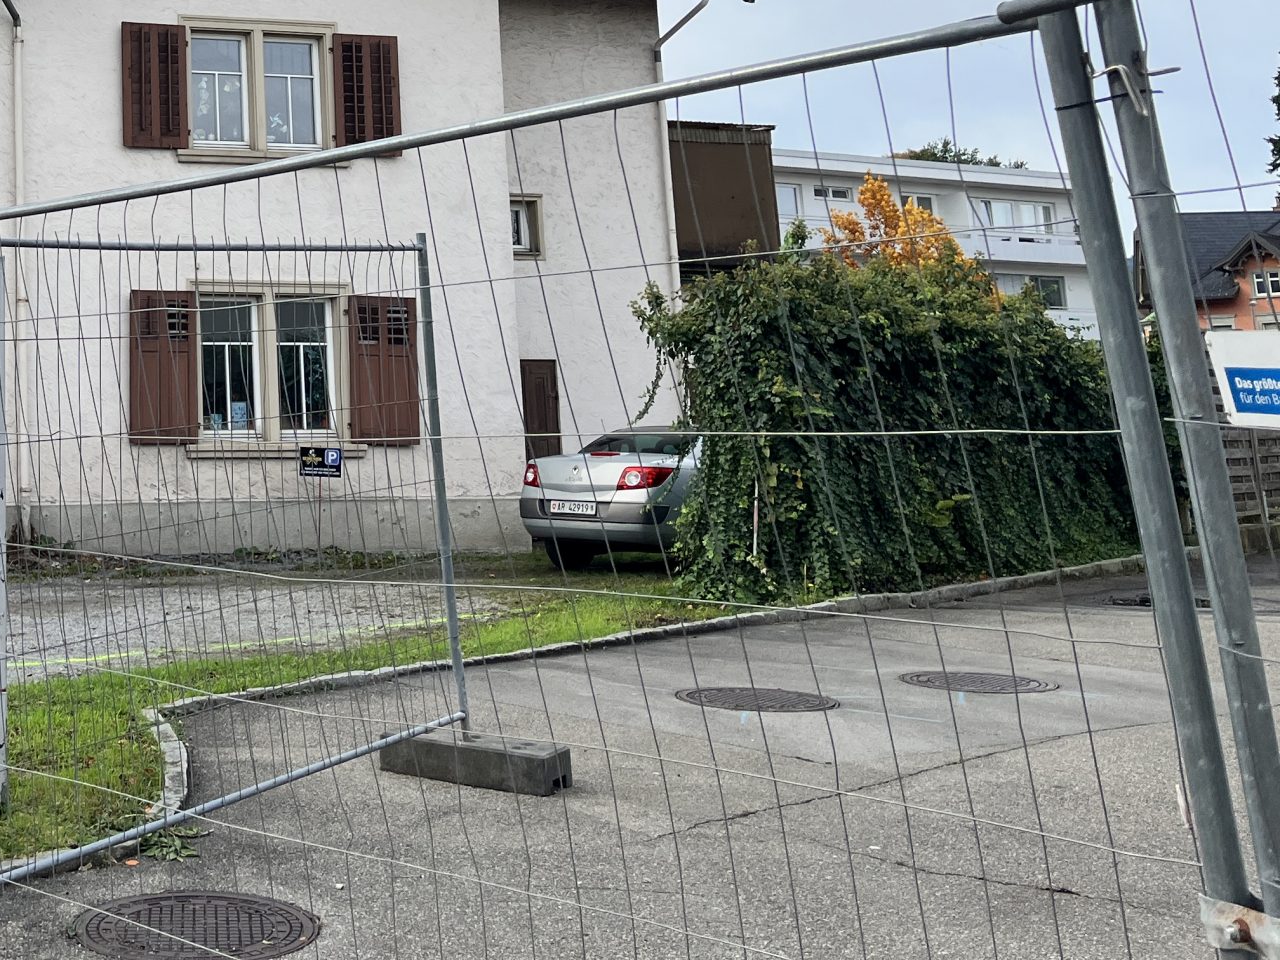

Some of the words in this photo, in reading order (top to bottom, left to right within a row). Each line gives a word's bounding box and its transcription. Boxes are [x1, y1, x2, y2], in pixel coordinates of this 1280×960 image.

[1235, 377, 1253, 388] Das
[1240, 392, 1253, 403] für
[1255, 393, 1271, 404] den
[1272, 394, 1280, 405] B
[557, 502, 566, 511] AR
[568, 503, 589, 513] 42919
